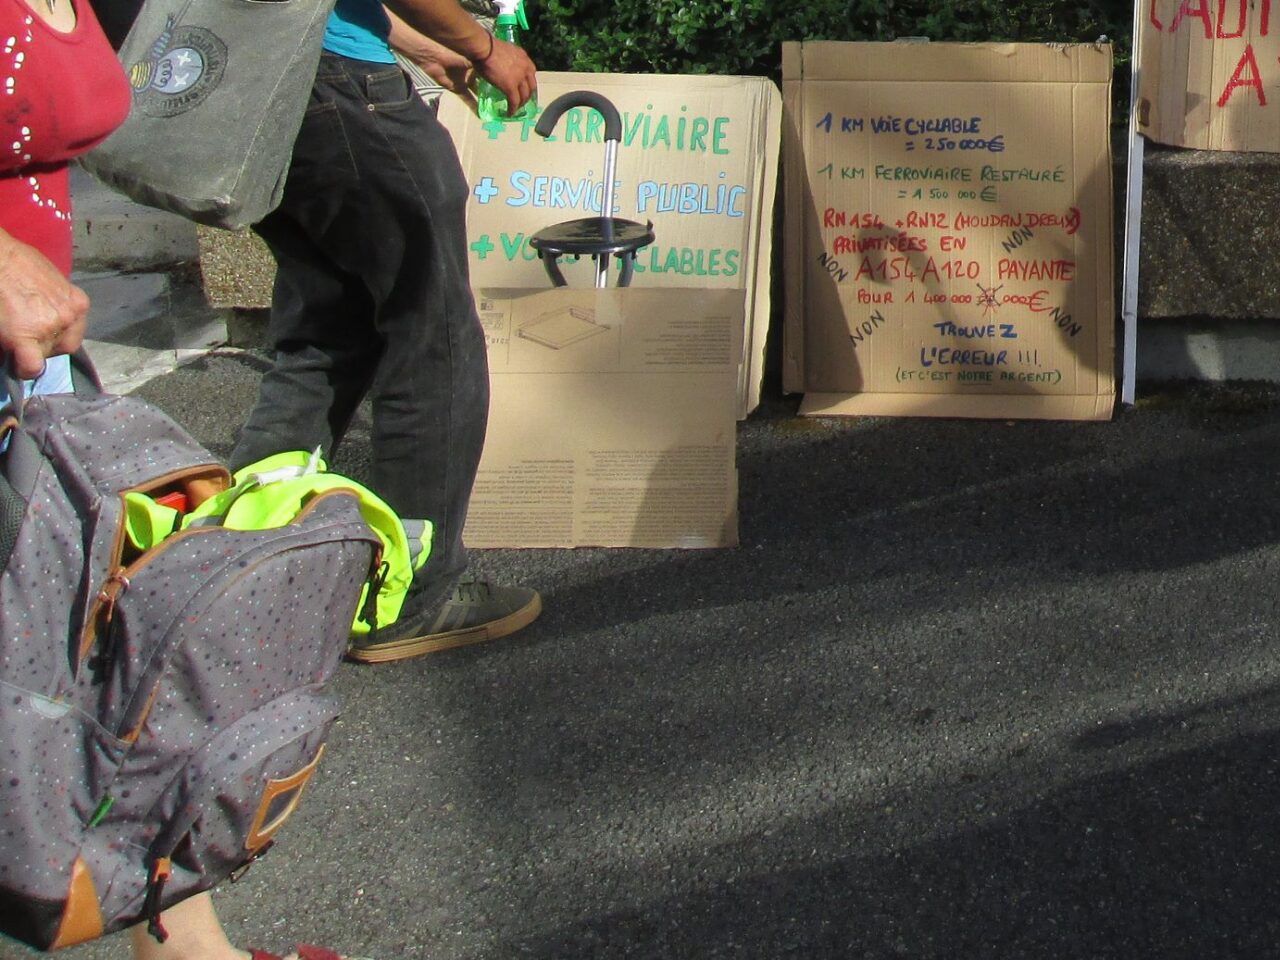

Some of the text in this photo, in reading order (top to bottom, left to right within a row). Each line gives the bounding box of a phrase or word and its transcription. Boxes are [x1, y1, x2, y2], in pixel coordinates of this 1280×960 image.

[816, 112, 833, 134] 1
[841, 117, 864, 133] KM
[904, 117, 982, 135] CYCLABLE
[817, 163, 1065, 183] 1 KM FERROVIAIRE RESTAURÉ
[637, 172, 747, 217] PUBLIC
[939, 235, 967, 252] EN
[1001, 224, 1035, 254] NON
[815, 252, 849, 282] NON
[855, 255, 1077, 283] A154 A120 PAYANTE
[857, 288, 894, 304] POUR
[850, 308, 886, 348] NON
[933, 321, 1018, 339] TROUVEZ
[1049, 305, 1083, 338] NON
[920, 346, 1008, 367] L'ERREUR
[957, 370, 993, 384] NOTRE
[1000, 369, 1062, 385] ARGENT)
